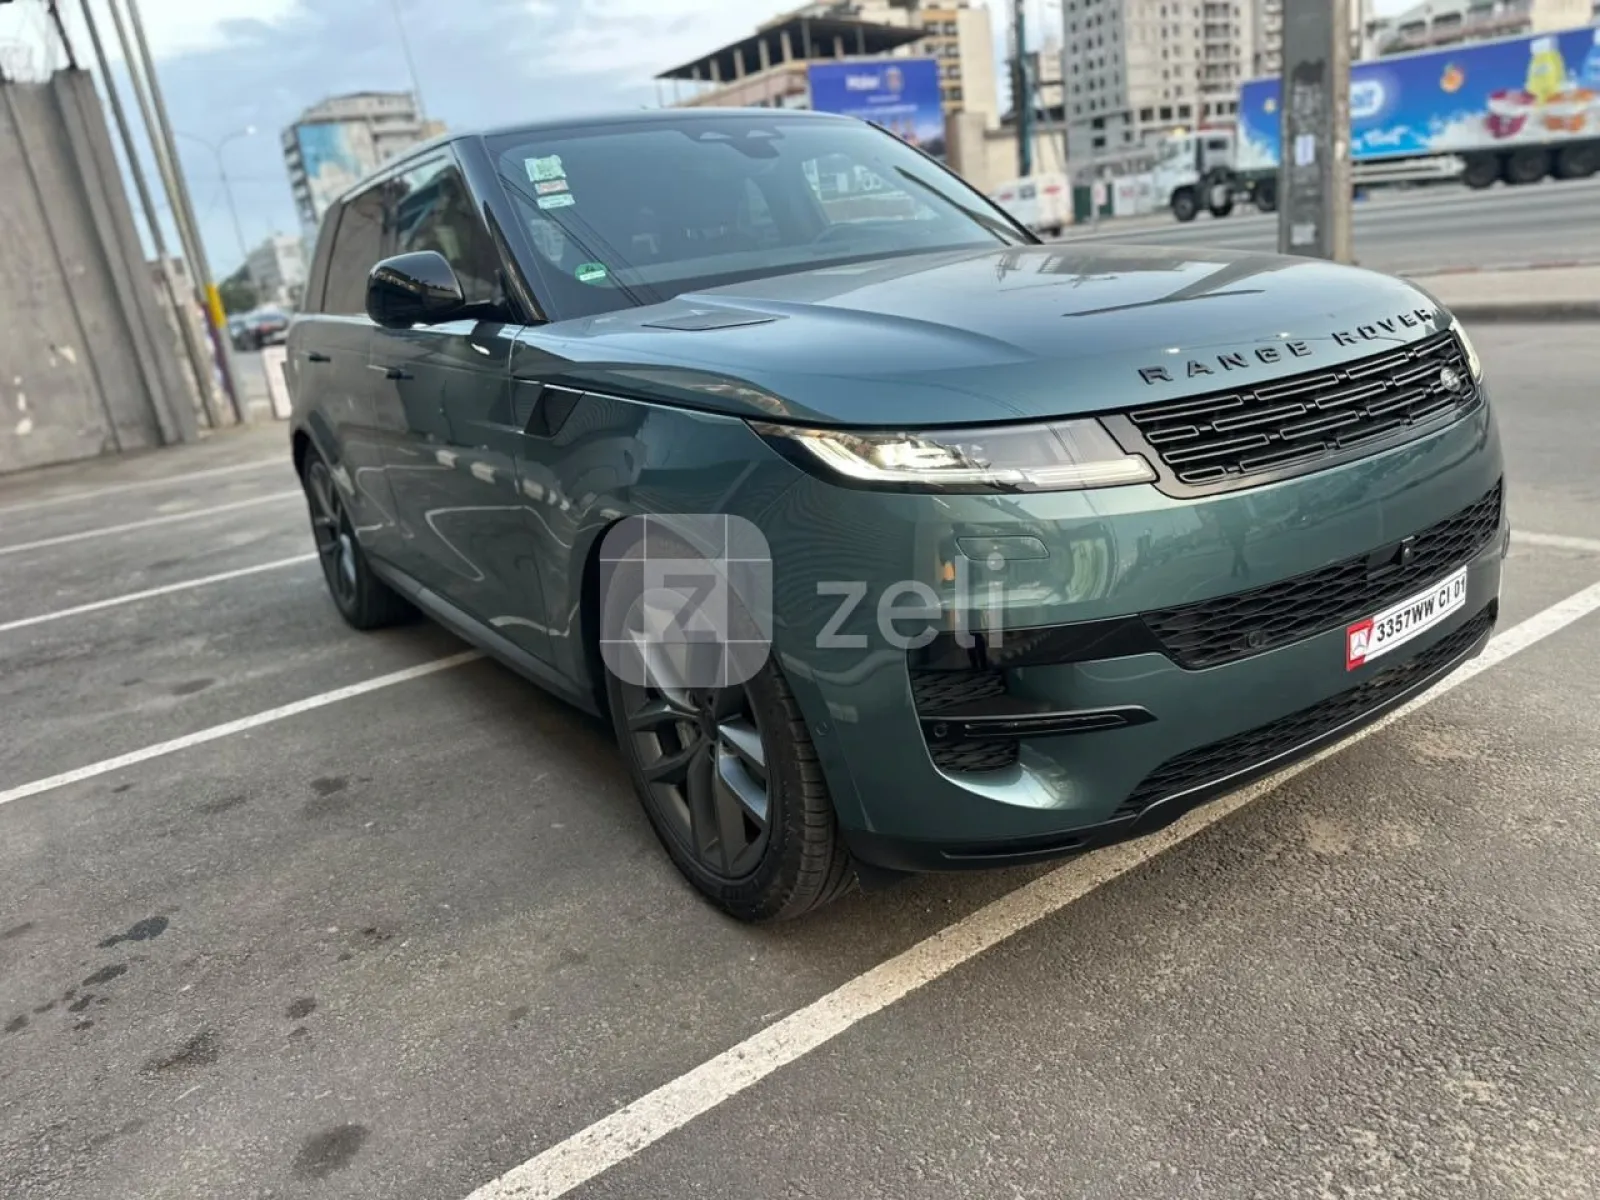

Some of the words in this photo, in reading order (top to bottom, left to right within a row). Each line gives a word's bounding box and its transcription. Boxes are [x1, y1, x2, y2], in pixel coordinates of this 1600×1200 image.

[1138, 341, 1312, 385] RANGE
[1331, 308, 1433, 346] ROVER
[1376, 596, 1435, 643] 3357WW
[1438, 585, 1450, 608] CI
